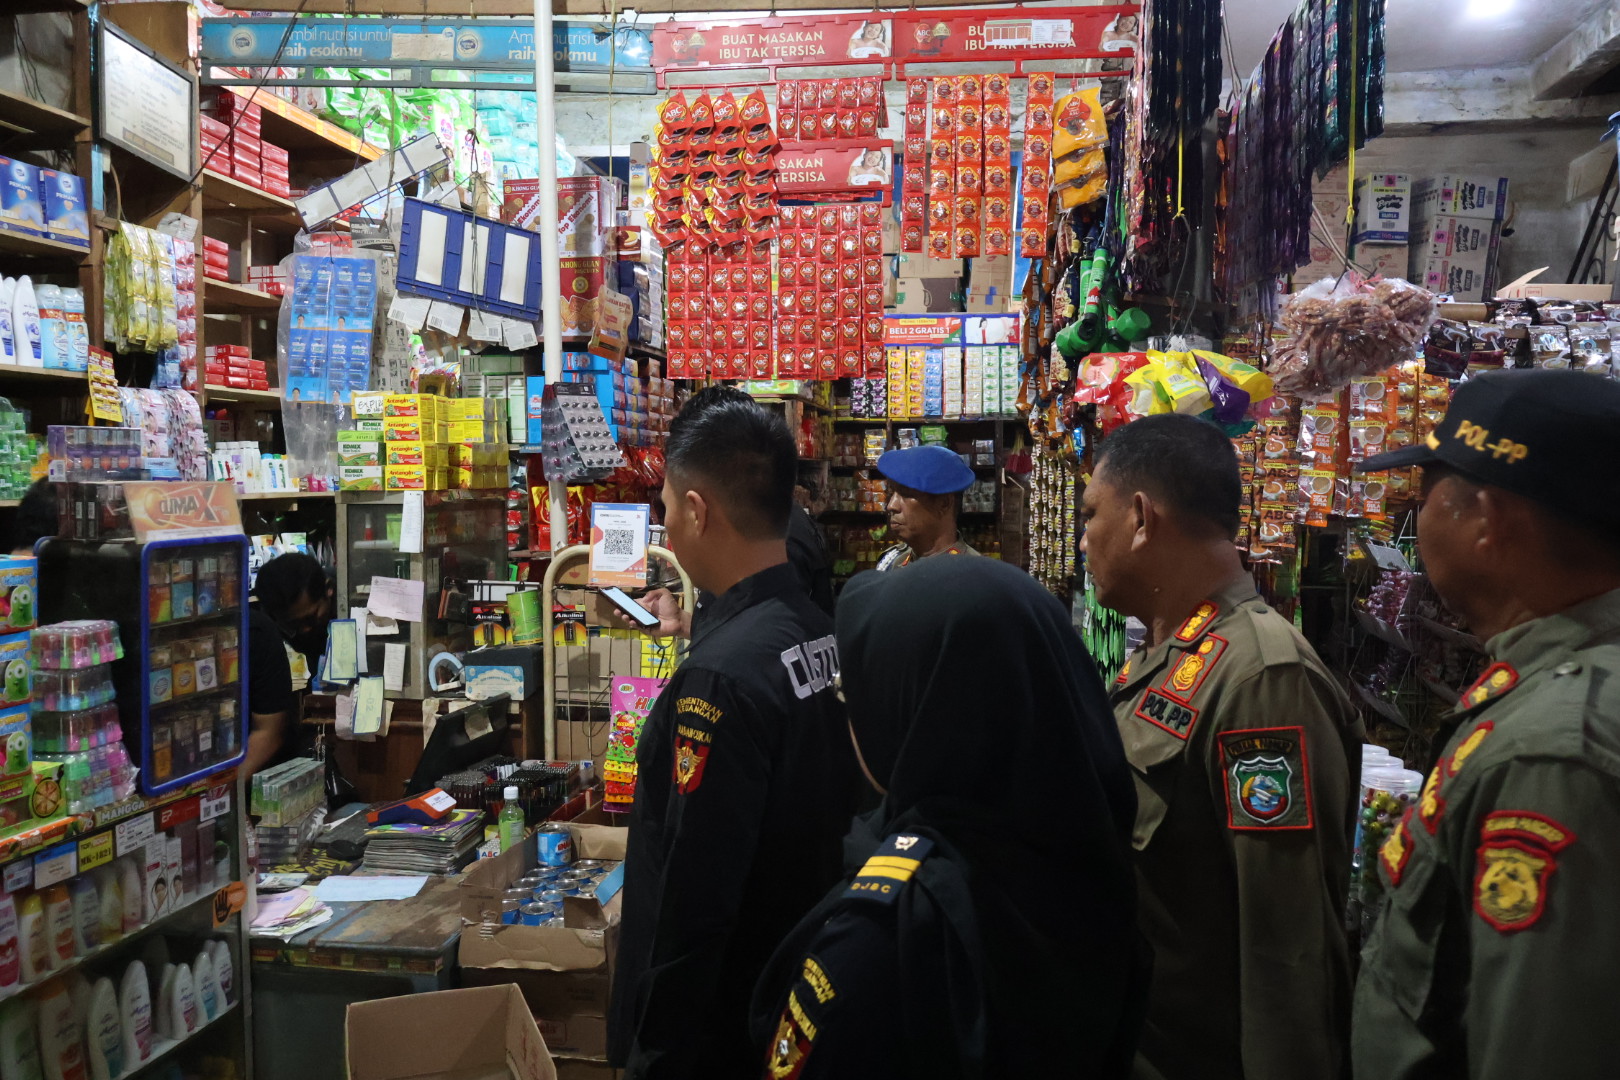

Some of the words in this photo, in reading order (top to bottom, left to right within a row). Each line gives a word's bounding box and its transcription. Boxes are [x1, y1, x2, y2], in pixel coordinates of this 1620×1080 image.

[320, 27, 358, 41] nutrisi
[722, 33, 755, 46] BUAT
[758, 30, 823, 44] MASAKAN
[968, 26, 986, 37] BU
[309, 44, 363, 57] esokmu
[719, 47, 740, 59] IBU
[744, 46, 770, 58] TAK
[772, 44, 825, 57] TERSISA
[965, 39, 987, 50] IBU
[508, 46, 536, 60] raih
[554, 49, 597, 62] okmu
[665, 106, 683, 118] ABC
[714, 105, 731, 117] ABC
[744, 103, 761, 115] ABC
[779, 157, 823, 169] SAKAN
[518, 198, 540, 223] Ekonom
[568, 193, 594, 223] Ekonomi
[889, 327, 907, 335] BELI
[1454, 420, 1528, 464] POL-PP
[1264, 511, 1293, 520] ABC
[781, 634, 840, 700] CUSTO
[676, 696, 723, 718] KEMENTERIAN
[677, 704, 719, 724] KEUANGAN
[1141, 695, 1164, 721] POL
[1166, 705, 1192, 730] PP
[100, 801, 146, 822] MANGGA
[481, 850, 498, 858] ABC
